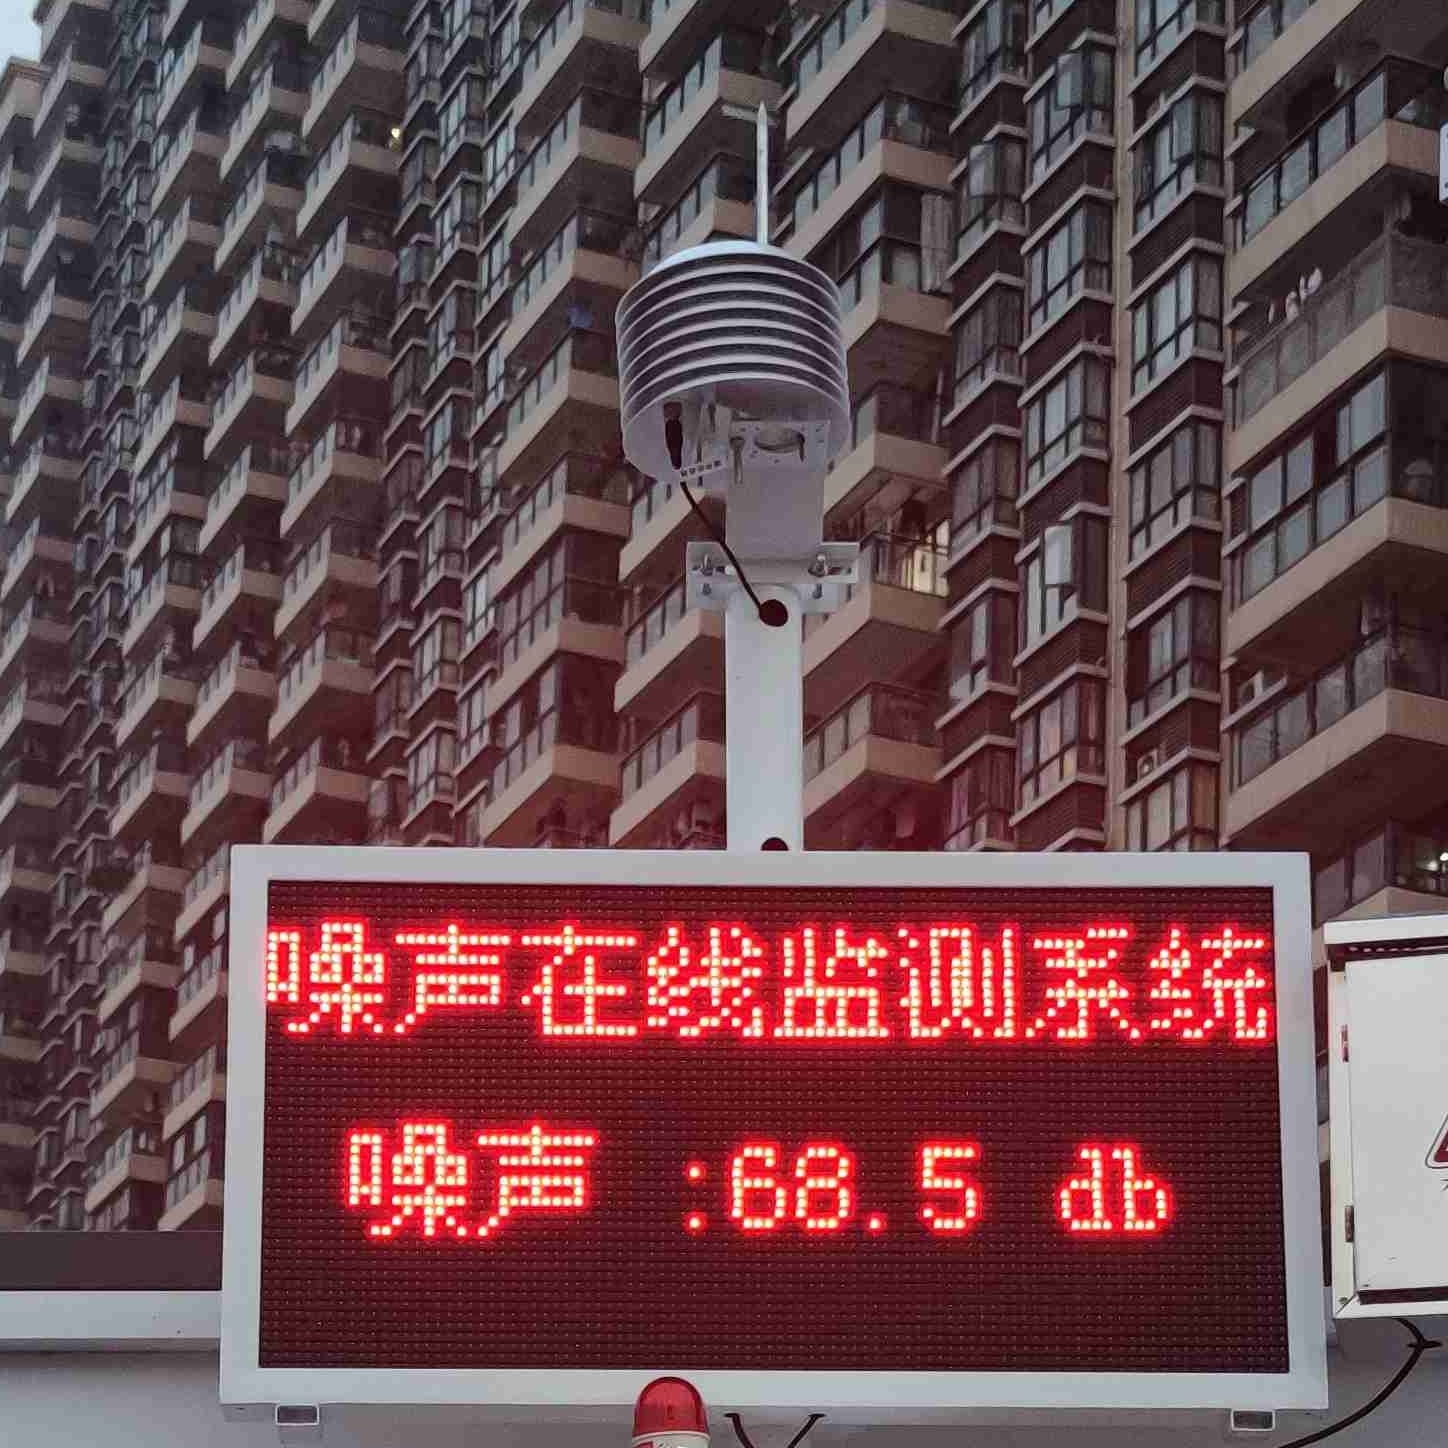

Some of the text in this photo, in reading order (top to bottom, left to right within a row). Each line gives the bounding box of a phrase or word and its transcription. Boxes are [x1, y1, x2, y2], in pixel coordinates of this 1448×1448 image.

[260, 919, 1270, 1042] 噪声在线监测系统
[348, 1121, 598, 1238] 噪声
[1058, 1145, 1170, 1233] db
